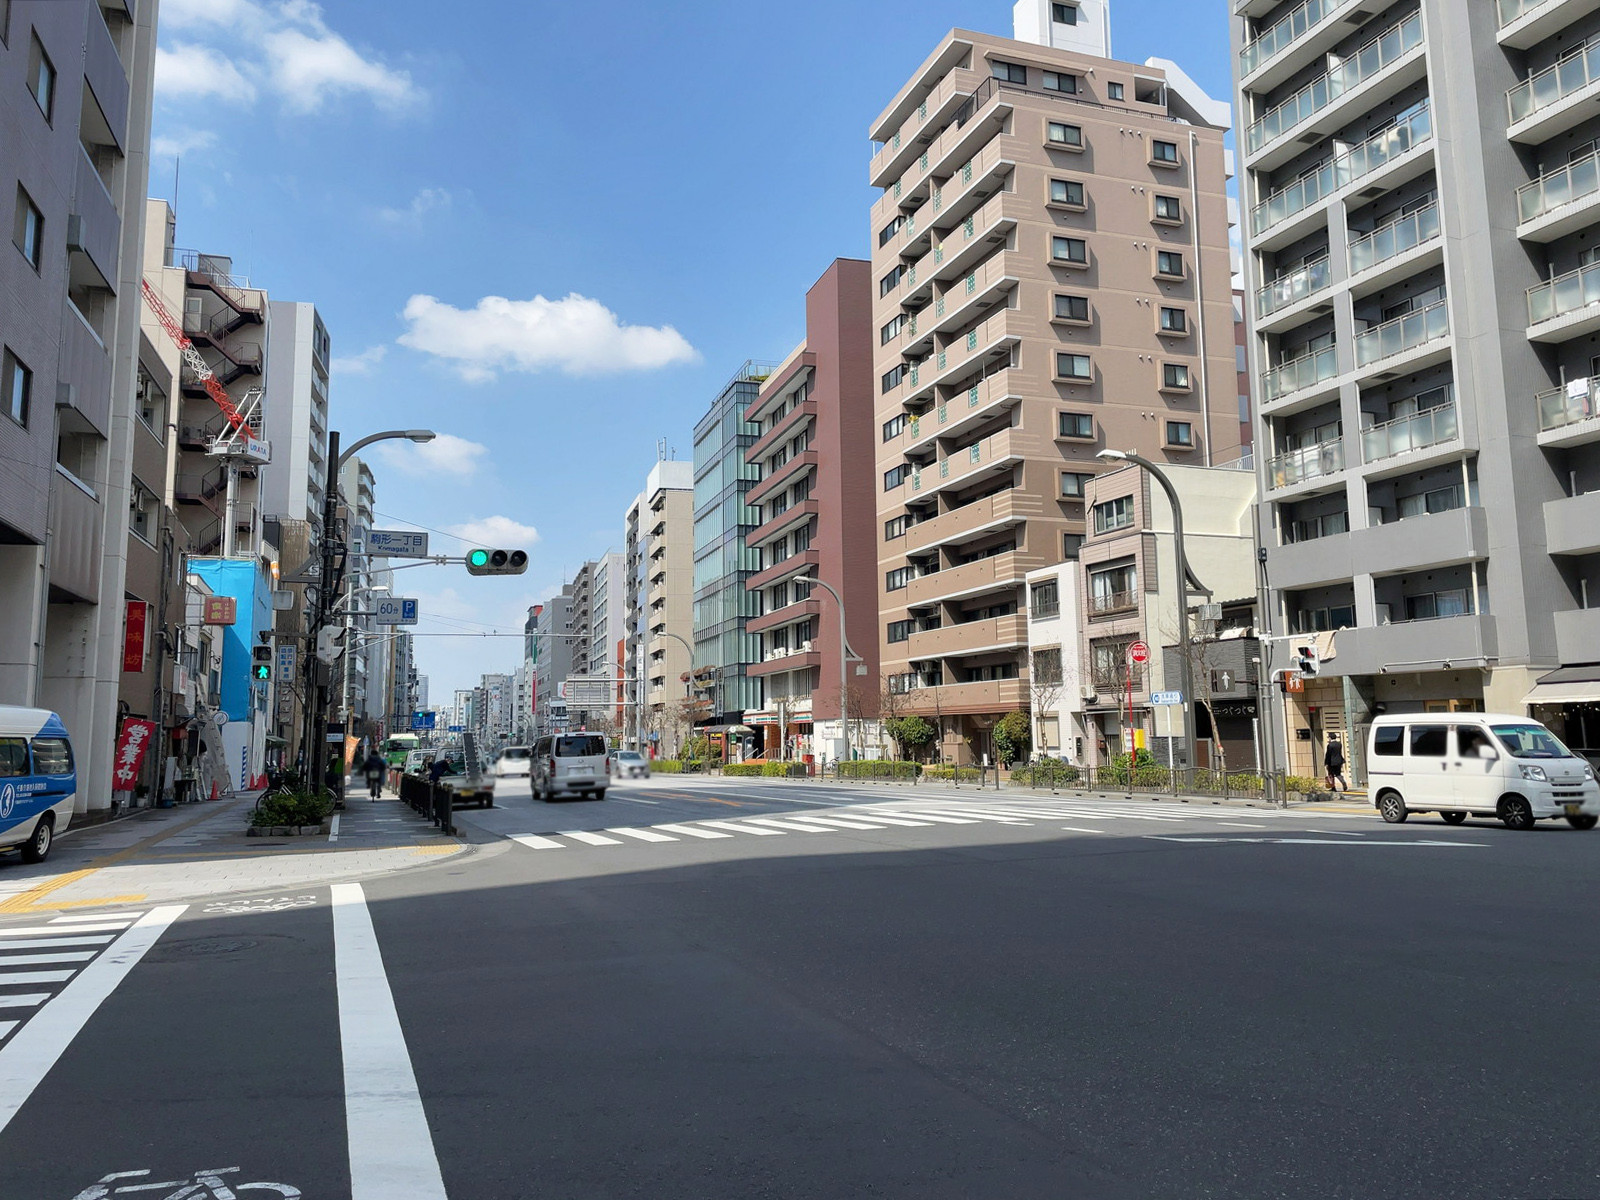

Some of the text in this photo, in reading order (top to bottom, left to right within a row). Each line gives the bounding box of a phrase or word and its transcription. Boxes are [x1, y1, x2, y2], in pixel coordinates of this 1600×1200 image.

[370, 534, 422, 546] 駒形一丁目
[380, 602, 399, 615] 60分
[405, 601, 414, 612] P
[116, 724, 149, 785] 営業中
